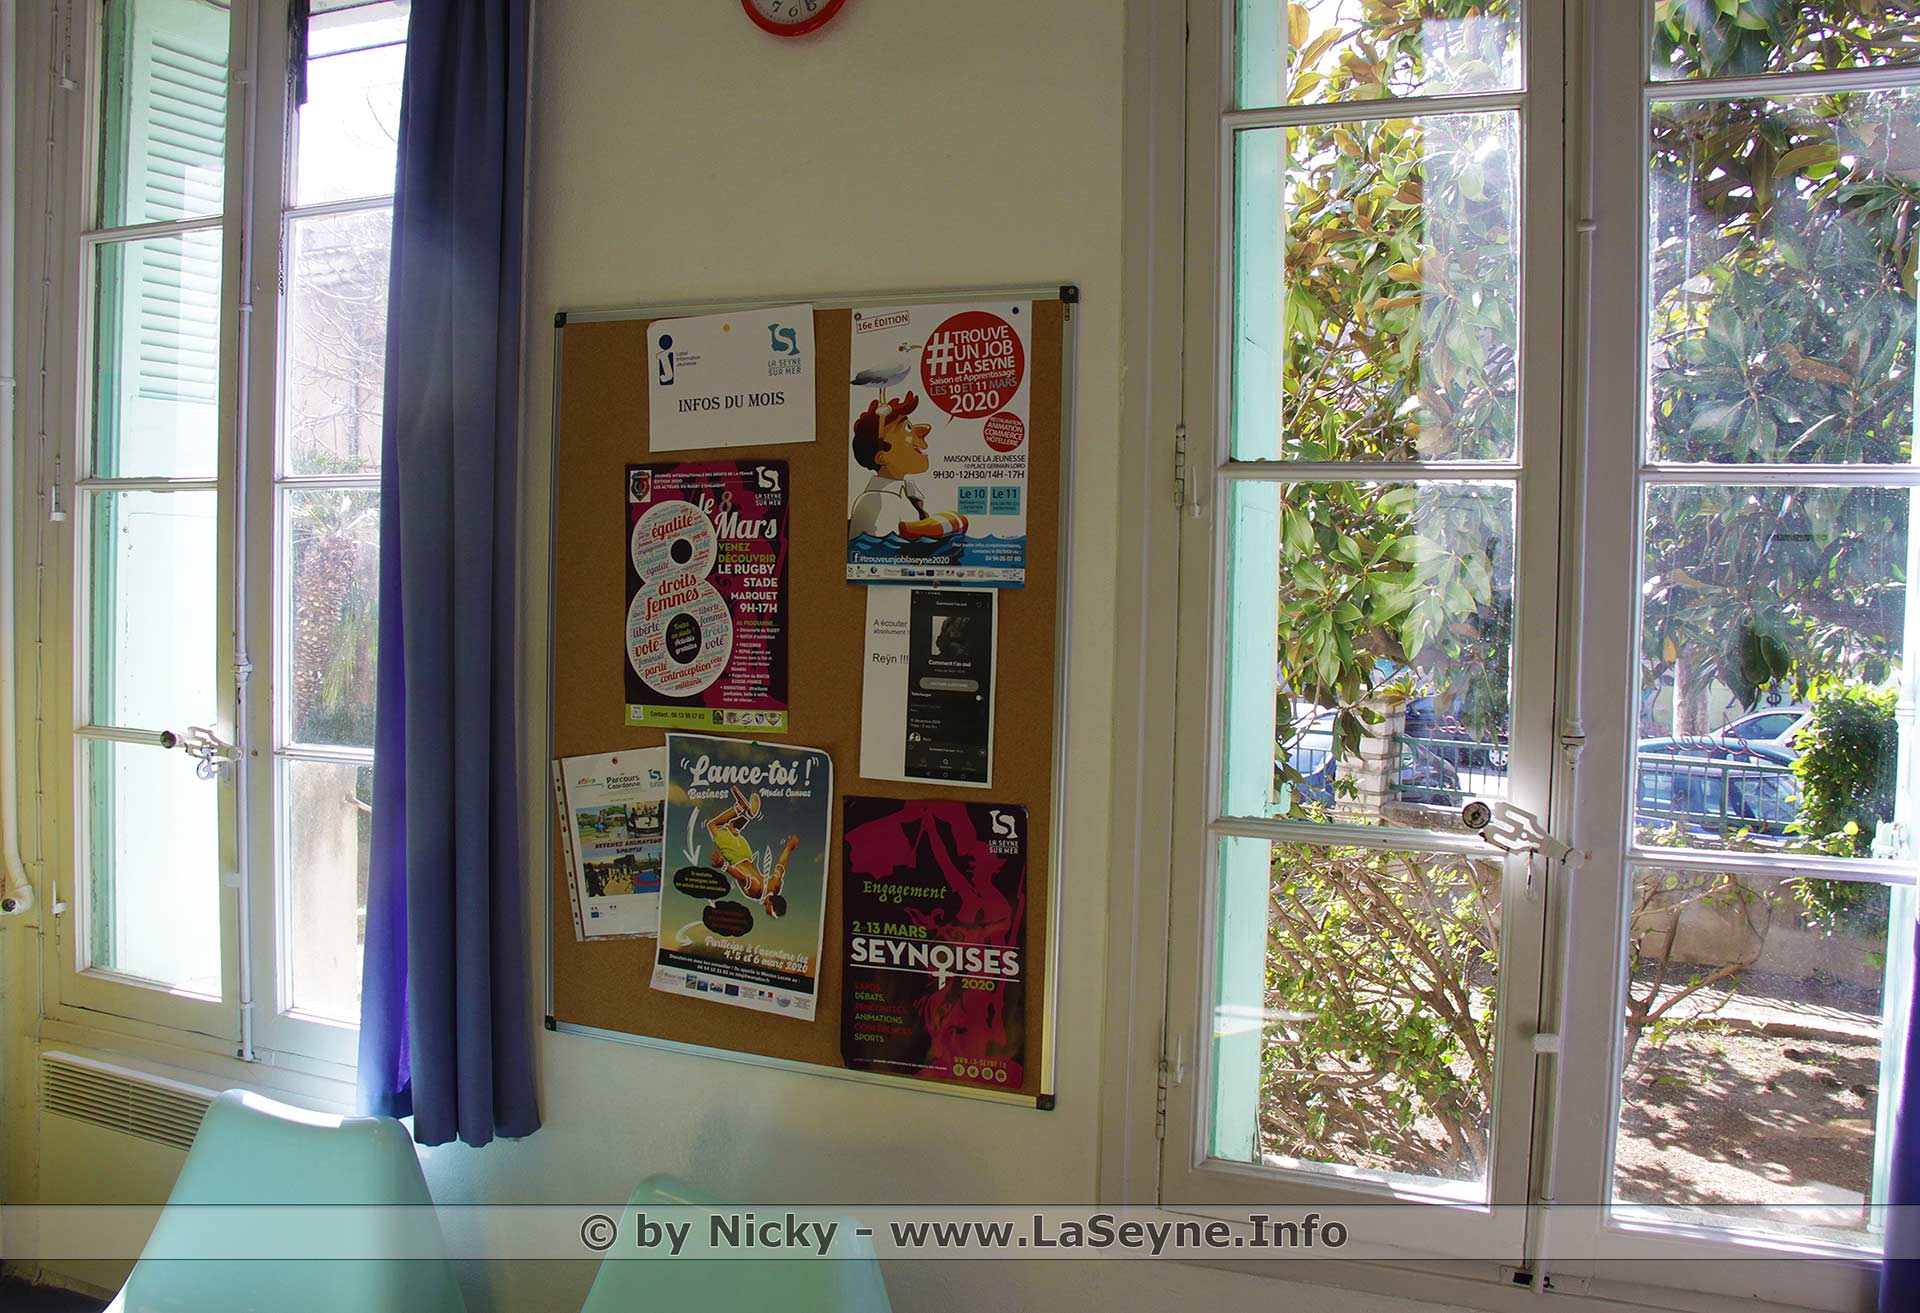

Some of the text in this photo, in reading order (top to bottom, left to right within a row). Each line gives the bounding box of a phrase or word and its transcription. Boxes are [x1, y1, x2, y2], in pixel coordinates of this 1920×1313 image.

[857, 313, 909, 331] 16e ÉDITION
[952, 325, 1010, 345] TROUVE
[954, 339, 1014, 361] UN JOB
[768, 357, 801, 367] LA SEYNE
[955, 355, 1015, 375] LA SEYNE
[768, 366, 801, 377] SUR MER
[929, 369, 1016, 386] Saison et Apprentissage
[930, 378, 1017, 397] LES 10 ET 11 MARS
[679, 391, 785, 413] INFOS DU MOIS
[950, 391, 1001, 414] 2020
[985, 428, 1023, 440] COMMERCE
[987, 421, 1023, 433] ANIMATION
[943, 455, 1025, 463] MAISON DE LA JEUNESSE
[933, 470, 955, 479] 9H30
[698, 490, 732, 514] le 8
[959, 488, 986, 499] Le 10
[992, 488, 1017, 499] Le 11
[652, 511, 694, 541] égalité
[714, 511, 778, 540] Mars
[718, 542, 751, 552] VENEZ
[718, 551, 777, 564] DÉCOUVRIR
[718, 563, 775, 575] LE RUGBY
[659, 573, 697, 596] droits
[743, 578, 779, 588] STADE
[645, 588, 699, 621] femmes
[730, 591, 778, 601] MARQUET
[739, 603, 778, 614] 9H-17H
[632, 621, 660, 639] liberté
[880, 619, 907, 627] écouter
[635, 639, 659, 657] vote
[644, 659, 667, 679] parité
[660, 662, 711, 684] contraception
[606, 775, 640, 785] Parcours
[687, 787, 729, 800] Business
[759, 787, 811, 798] Model Canvas
[988, 839, 1019, 849] LA SEYNE
[989, 847, 1019, 856] SUR MER
[863, 880, 949, 904] Engagement
[883, 922, 928, 939] MARS
[704, 935, 744, 953] Participe
[734, 951, 741, 960] 5
[743, 952, 752, 963] et
[753, 954, 760, 965] 6
[761, 958, 783, 968] mars
[785, 960, 808, 974] 2020
[850, 937, 1020, 977] SEYNOISES
[961, 978, 996, 992] 2020
